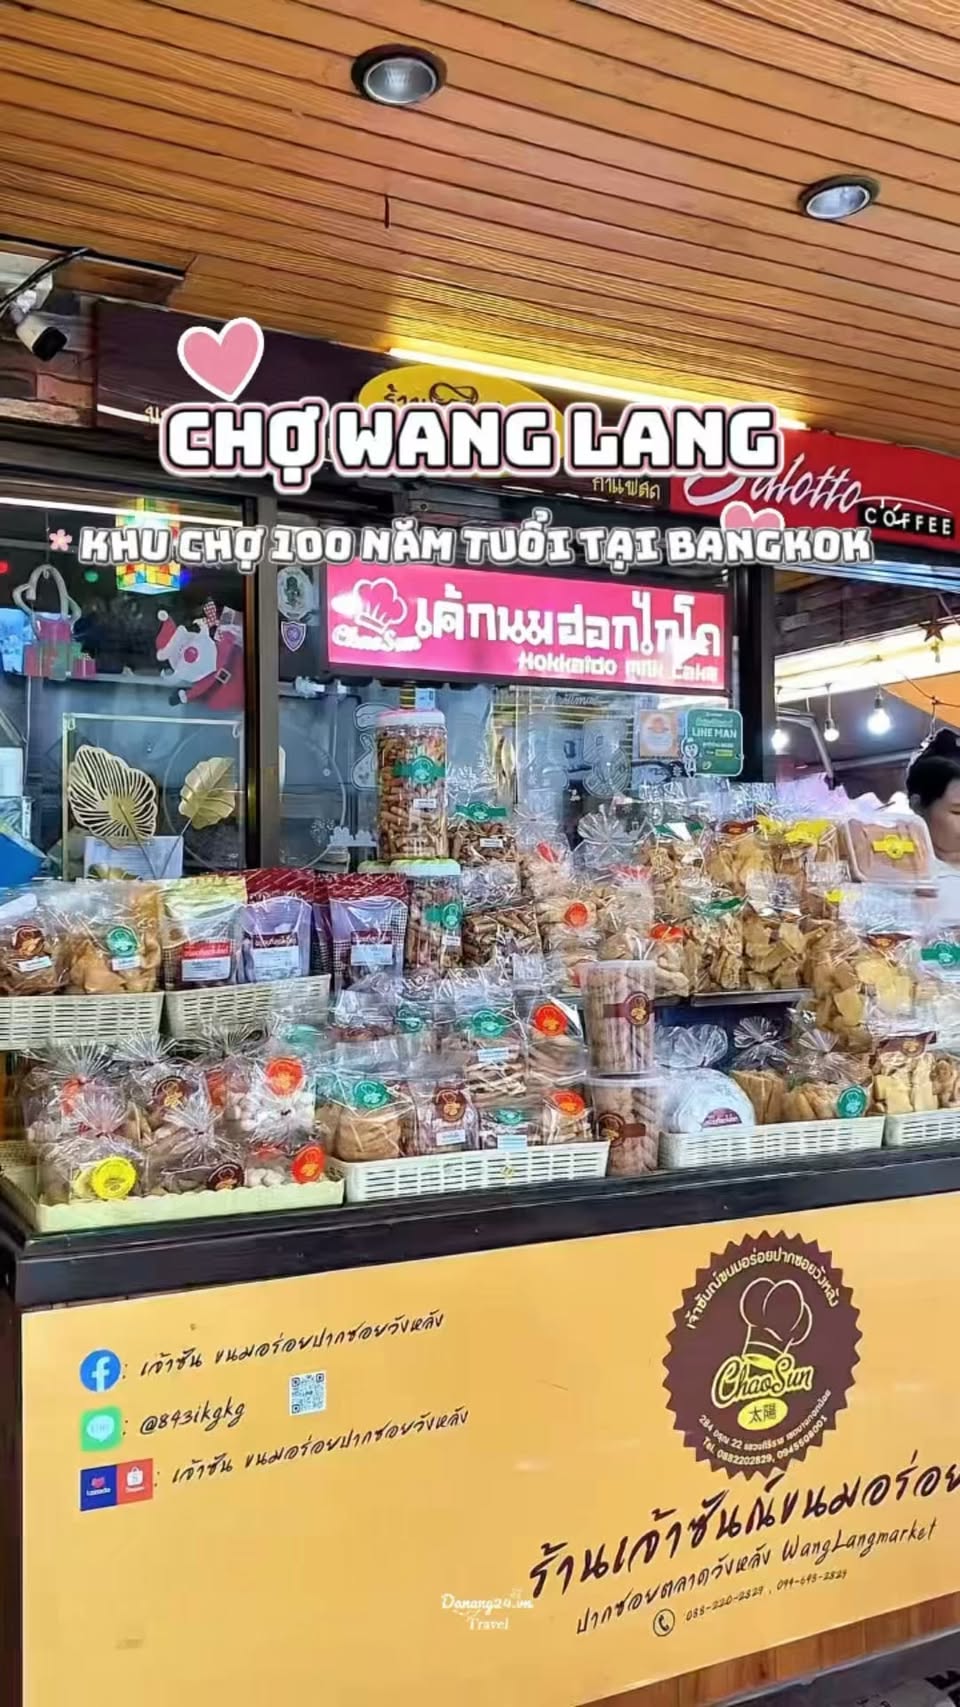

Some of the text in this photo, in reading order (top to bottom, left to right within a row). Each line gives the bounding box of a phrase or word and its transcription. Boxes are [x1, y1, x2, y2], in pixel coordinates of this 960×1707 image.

[863, 507, 952, 537] COFFEE
[414, 583, 721, 658] เค้กนมฮอกไกโด
[519, 652, 617, 676] Hokkaido
[692, 727, 737, 738] LINE MAN
[141, 1347, 203, 1377] เจ้าซัน
[140, 1396, 246, 1435] @843ikgkg
[699, 1414, 714, 1432] 284
[731, 1438, 742, 1450] 22
[172, 1453, 233, 1484] เจ้าซัน
[781, 1517, 937, 1568] WangLangmarket
